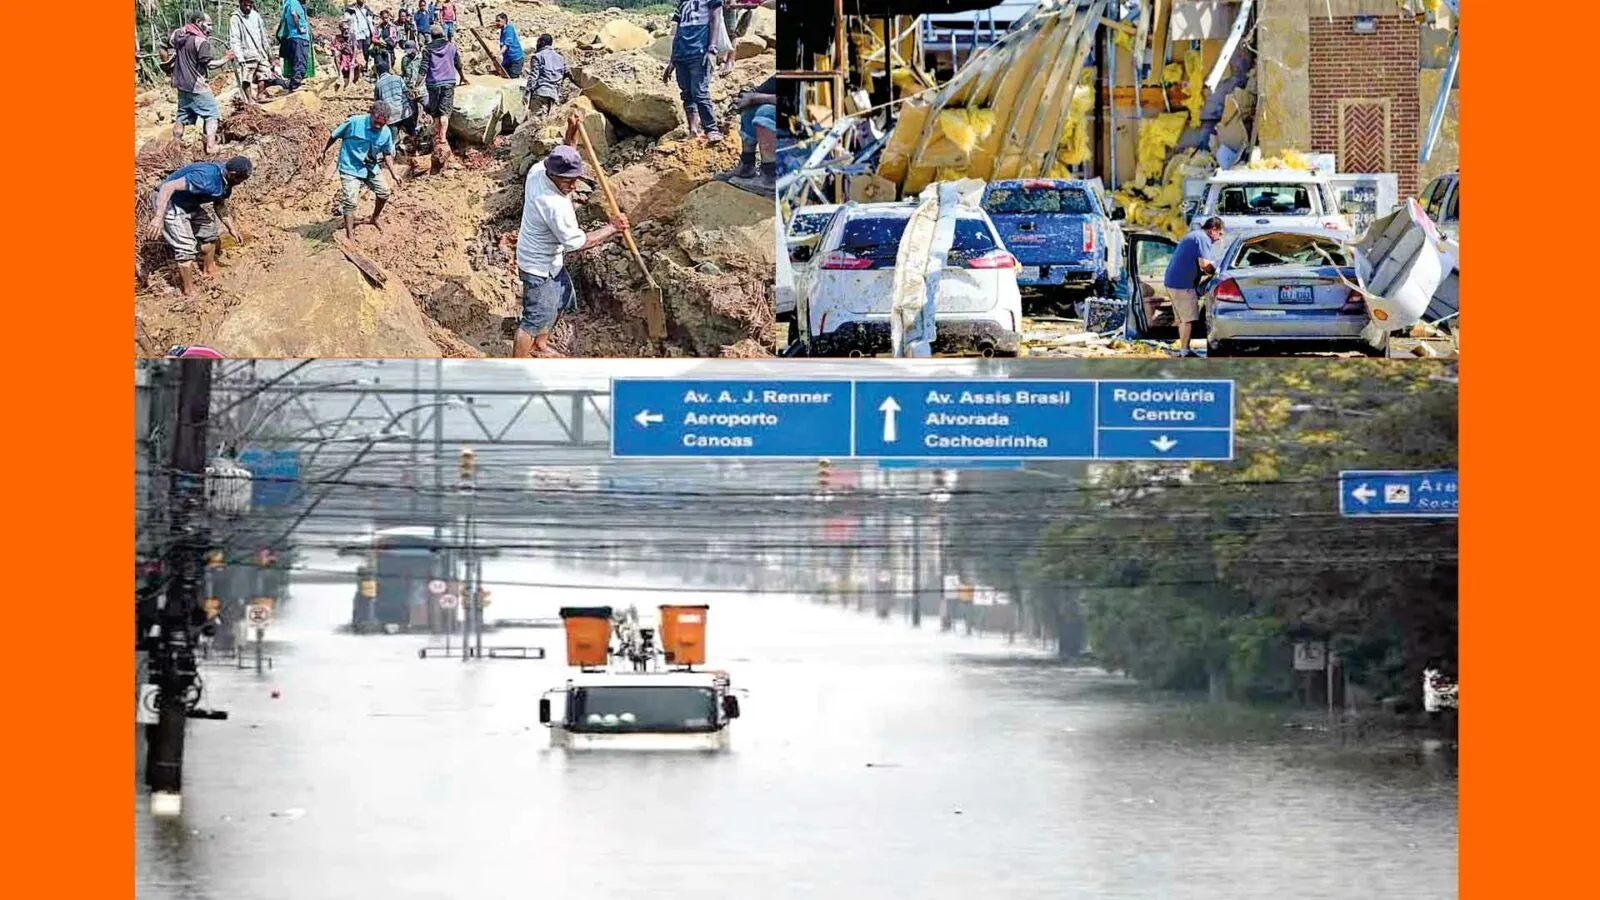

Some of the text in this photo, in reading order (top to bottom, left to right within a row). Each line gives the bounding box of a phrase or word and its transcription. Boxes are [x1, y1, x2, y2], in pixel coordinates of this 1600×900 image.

[684, 390, 832, 403] Av. A. J. Renner
[926, 390, 1070, 405] Av. Assis Brasil
[1113, 388, 1215, 402] Rodoviária
[684, 412, 778, 427] Aeroporto
[926, 412, 1009, 426] Alvorada
[1132, 408, 1196, 421] Centro
[683, 433, 753, 447] Canoas
[924, 434, 1048, 448] Cachoeirinha
